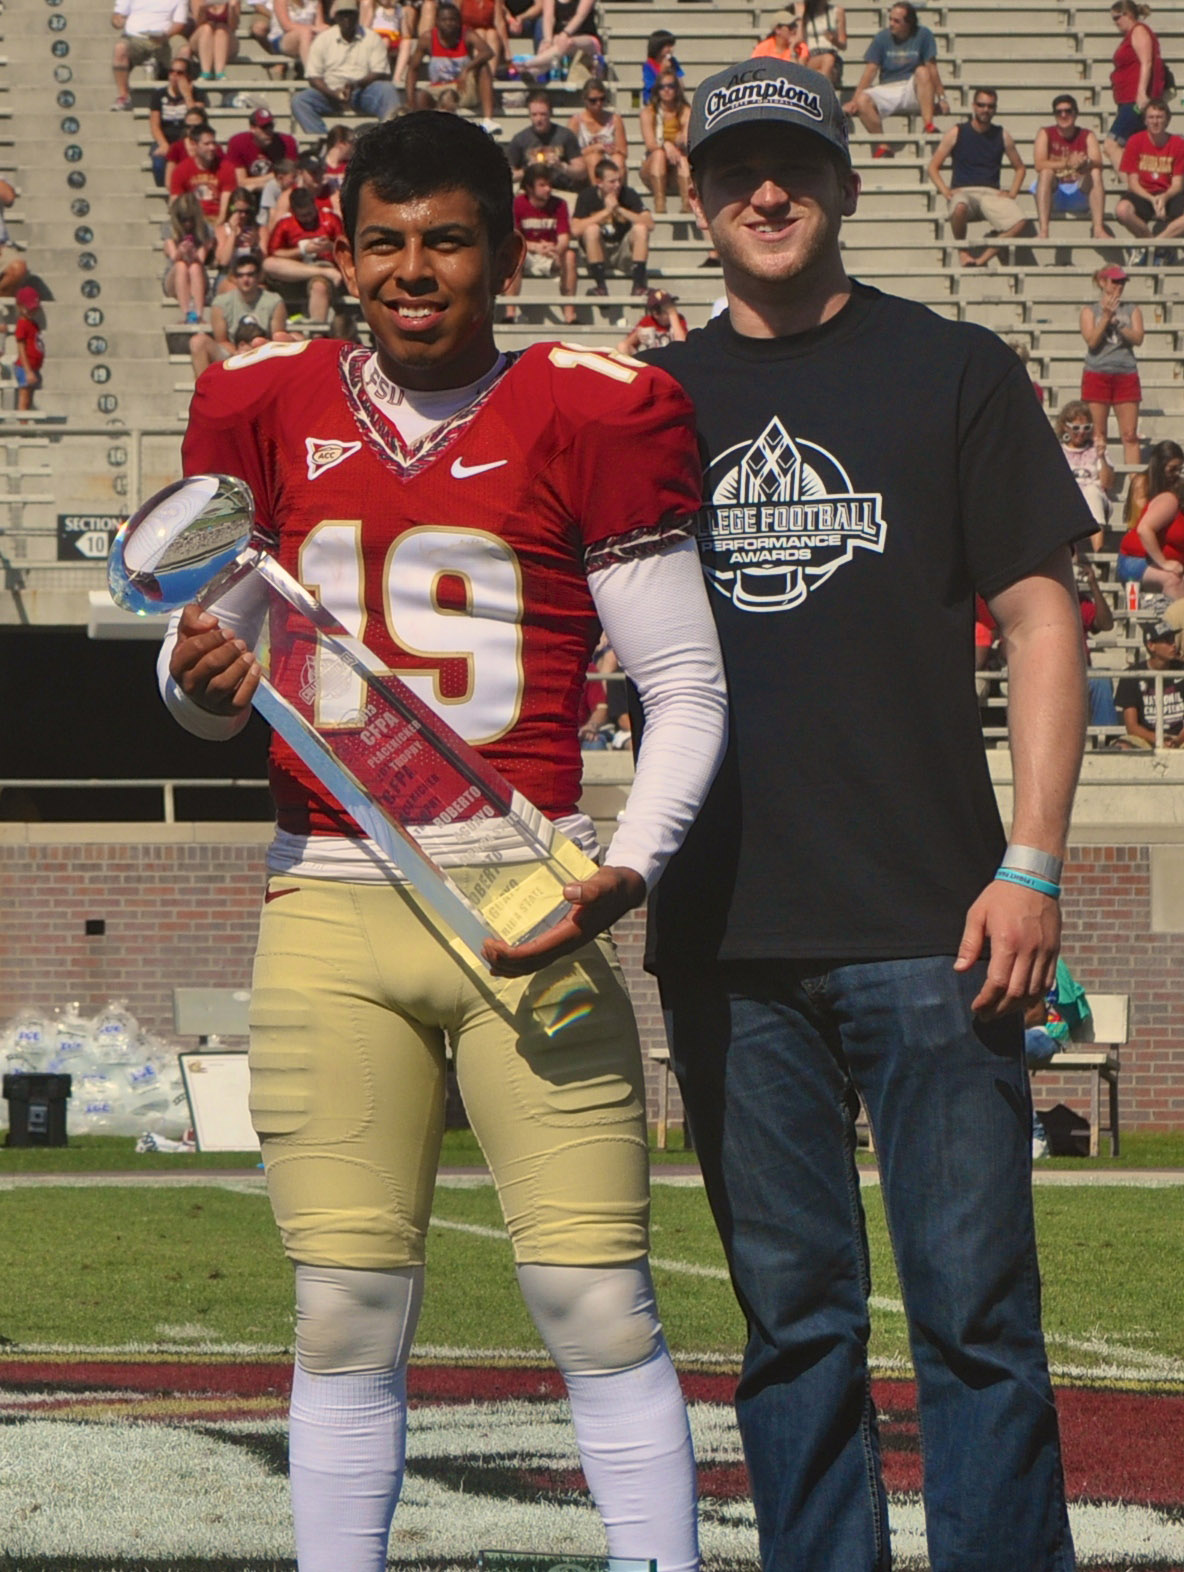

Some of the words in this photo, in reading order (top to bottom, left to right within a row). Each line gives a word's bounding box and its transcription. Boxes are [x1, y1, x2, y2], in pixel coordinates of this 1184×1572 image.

[727, 68, 766, 90] ACC
[706, 78, 820, 116] Champions
[87, 311, 101, 325] 21
[366, 367, 405, 406] FSU
[100, 397, 115, 410] 18
[110, 449, 125, 463] 16
[318, 450, 336, 460] ACC
[65, 517, 122, 531] SECTION
[697, 507, 757, 536] LLEGE
[760, 501, 877, 535] FOOTBALL
[88, 537, 104, 549] 10
[701, 535, 841, 552] PERFORMANCE
[729, 549, 812, 564] AWARDS
[298, 520, 524, 746] 19
[360, 712, 400, 746] CFPA
[389, 741, 423, 771] TROPHY
[432, 785, 481, 829] ROBERTO
[470, 849, 503, 907] OBERTO
